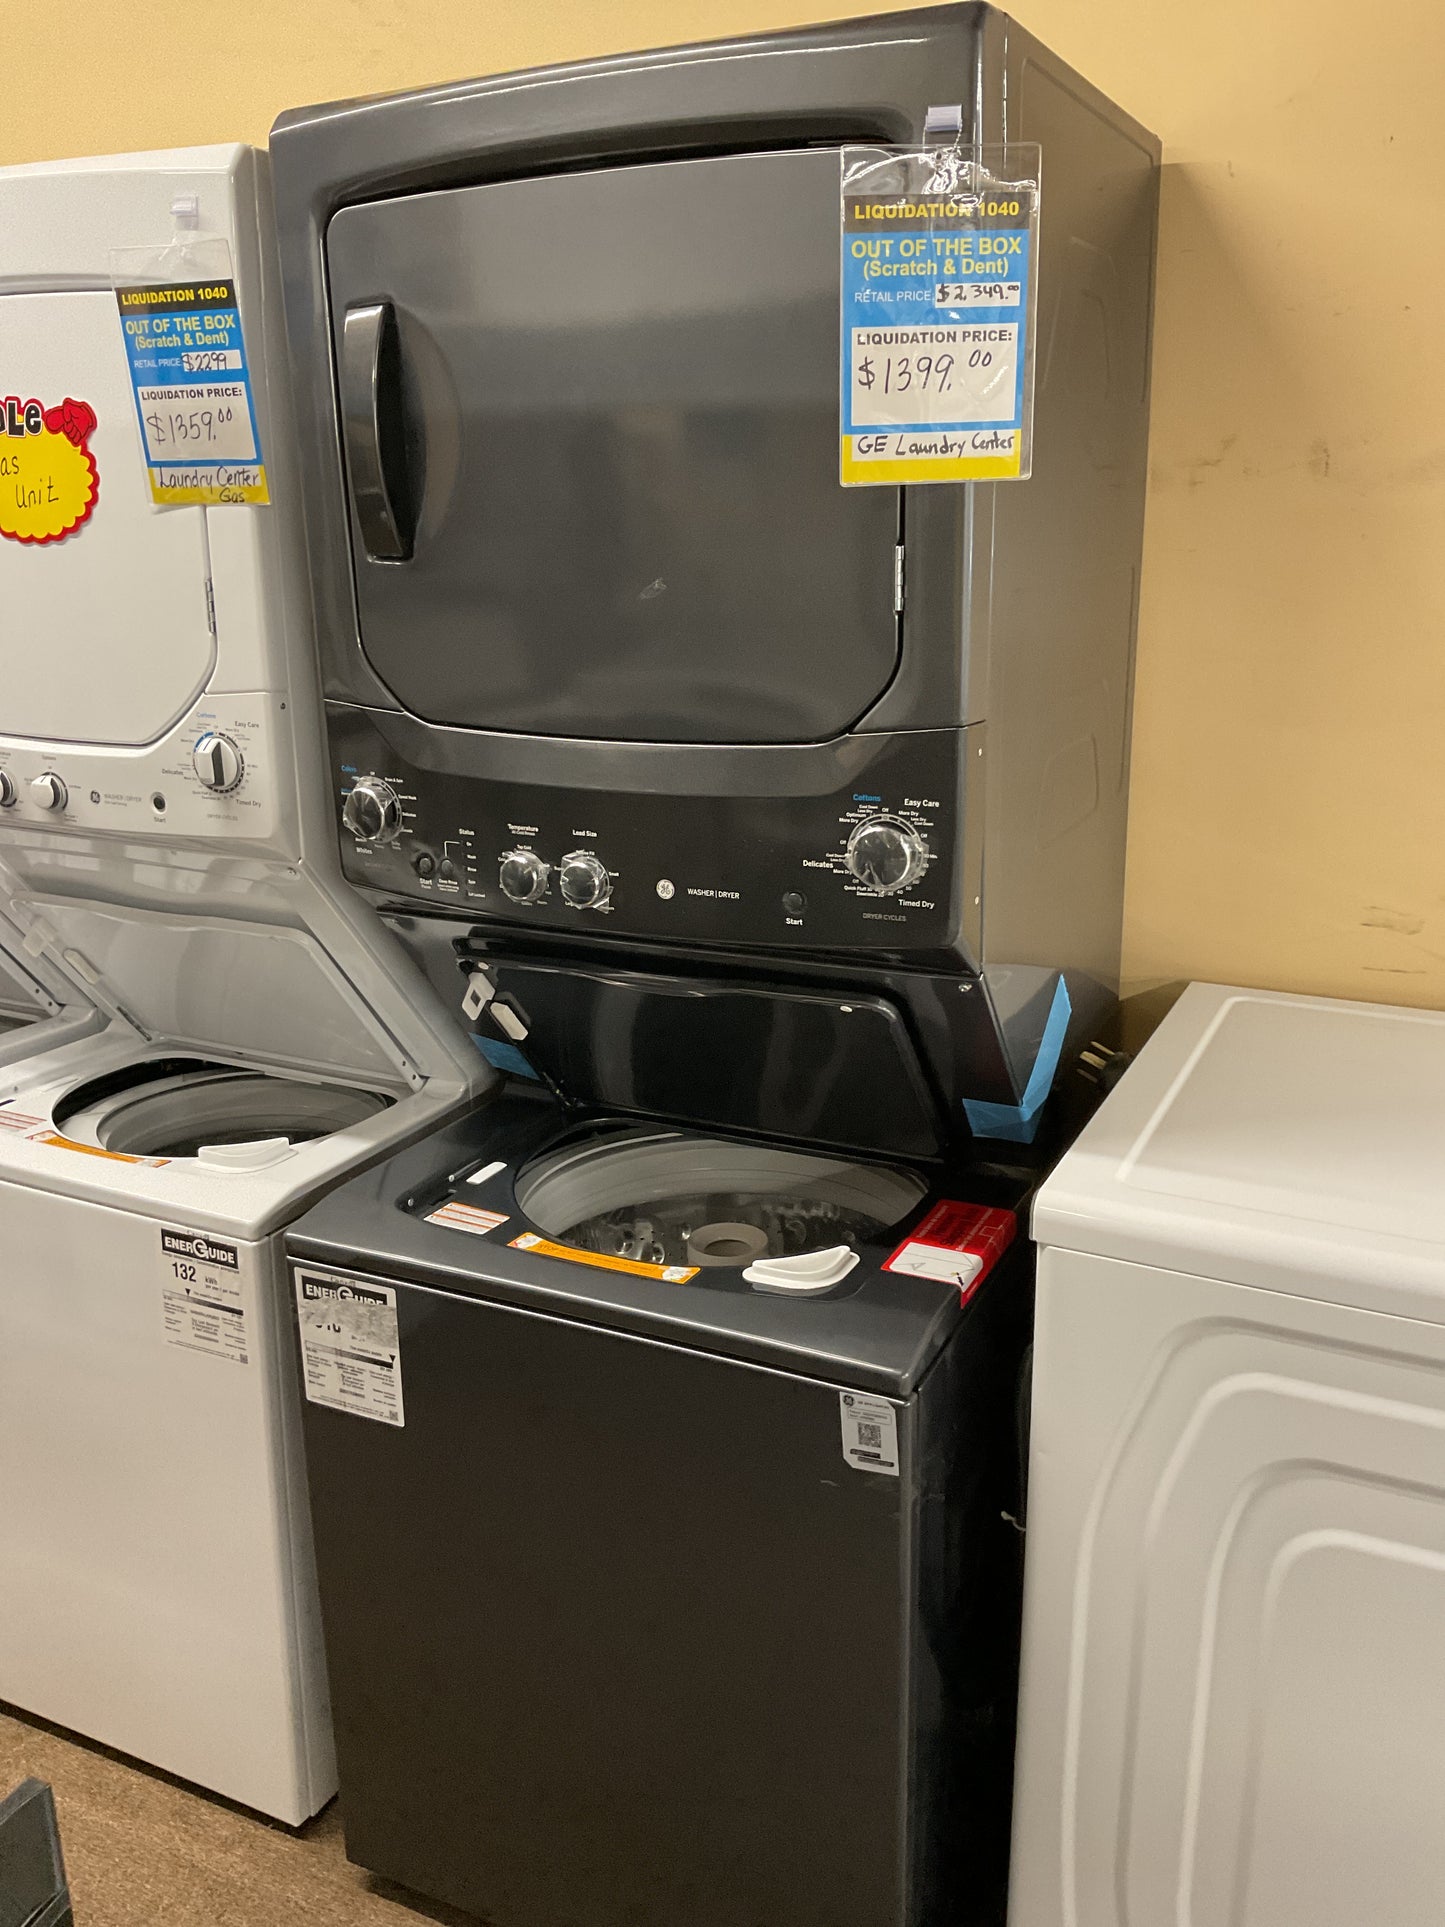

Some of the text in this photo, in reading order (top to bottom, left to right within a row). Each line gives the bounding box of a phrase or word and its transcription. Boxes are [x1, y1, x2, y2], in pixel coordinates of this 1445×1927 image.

[855, 201, 1020, 220] LIQUIDATION 1040
[851, 237, 1022, 258] OUT OF THE BOX
[863, 256, 1009, 281] (Scratch & Dent)
[121, 286, 229, 306] LIQUIDATION 1040
[854, 289, 893, 303] RETAIL
[125, 313, 236, 336] OUT OF THE BOX
[134, 331, 229, 352] (Scratch & Dent)
[856, 329, 1013, 346] LIQUIDATION PRICE:
[134, 359, 157, 369] RETAIL
[140, 387, 243, 401] LIQUIDATION PRICE:
[856, 430, 1016, 459] GE Laundry Center
[158, 465, 260, 490] Laundry Center
[15, 475, 59, 509] Unit
[219, 487, 246, 504] Gas
[904, 798, 940, 808] Easy Care
[507, 823, 539, 833] Temperature
[572, 829, 598, 838] Load Size
[802, 859, 834, 869] Delicates
[898, 898, 935, 909] Timed Dry
[785, 917, 803, 926] Start
[164, 1236, 235, 1264] ENERGUIDE
[172, 1262, 197, 1283] 132
